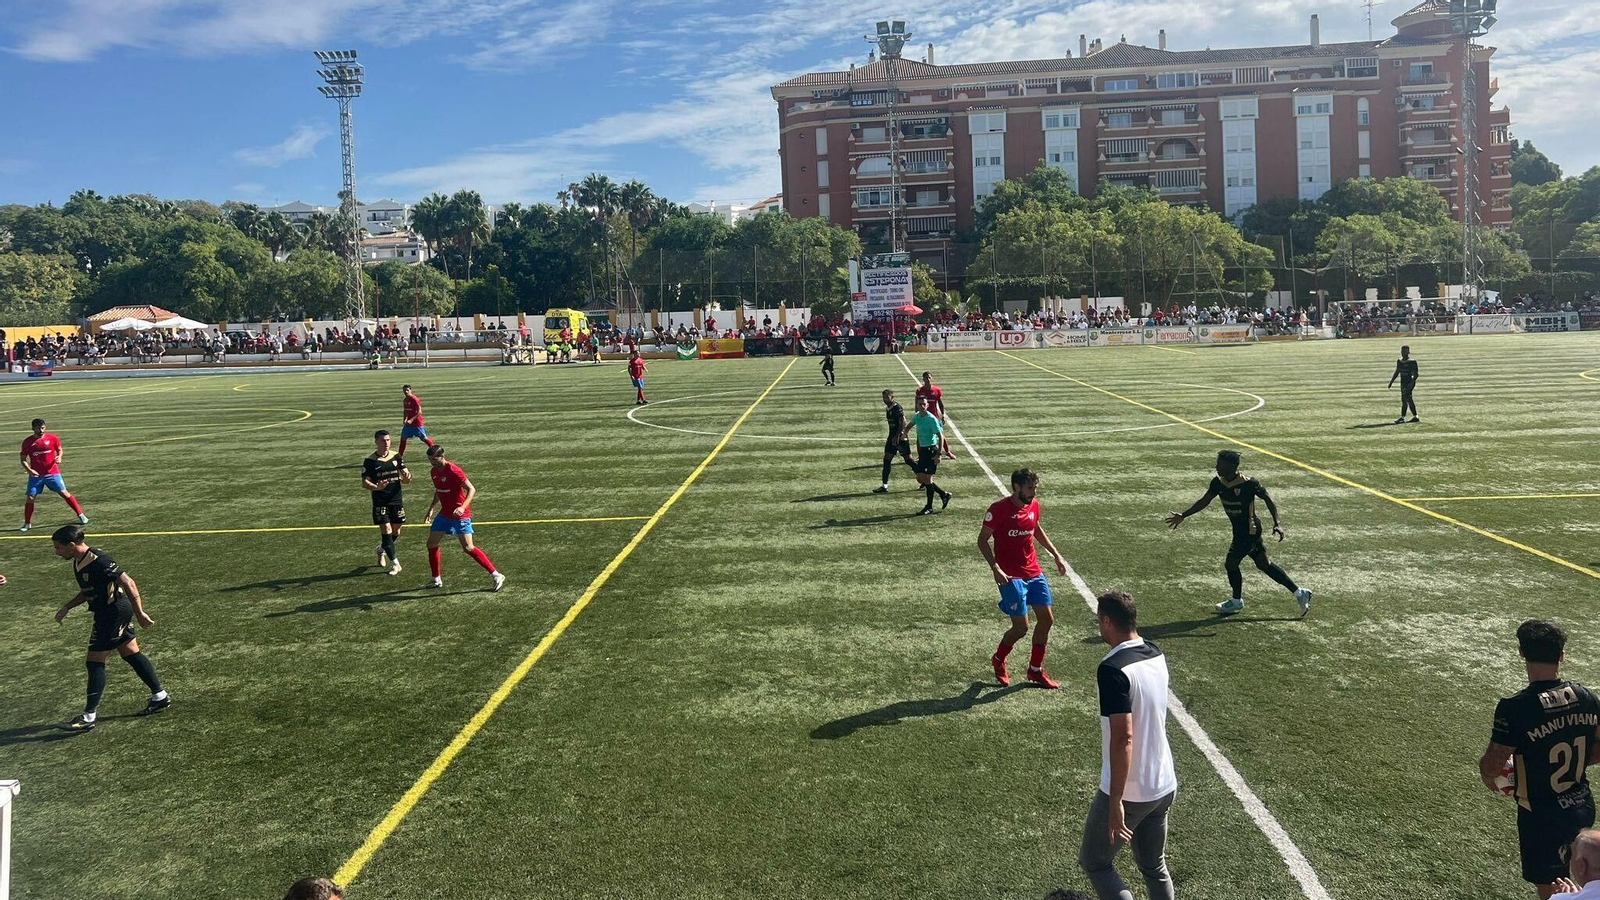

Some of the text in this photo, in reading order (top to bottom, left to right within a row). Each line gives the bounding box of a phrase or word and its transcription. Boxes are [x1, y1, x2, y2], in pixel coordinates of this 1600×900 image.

[865, 277, 908, 286] ESTEPONA
[1525, 317, 1566, 326] MBH
[1527, 713, 1598, 742] MANU VIANA
[1549, 735, 1586, 794] 21
